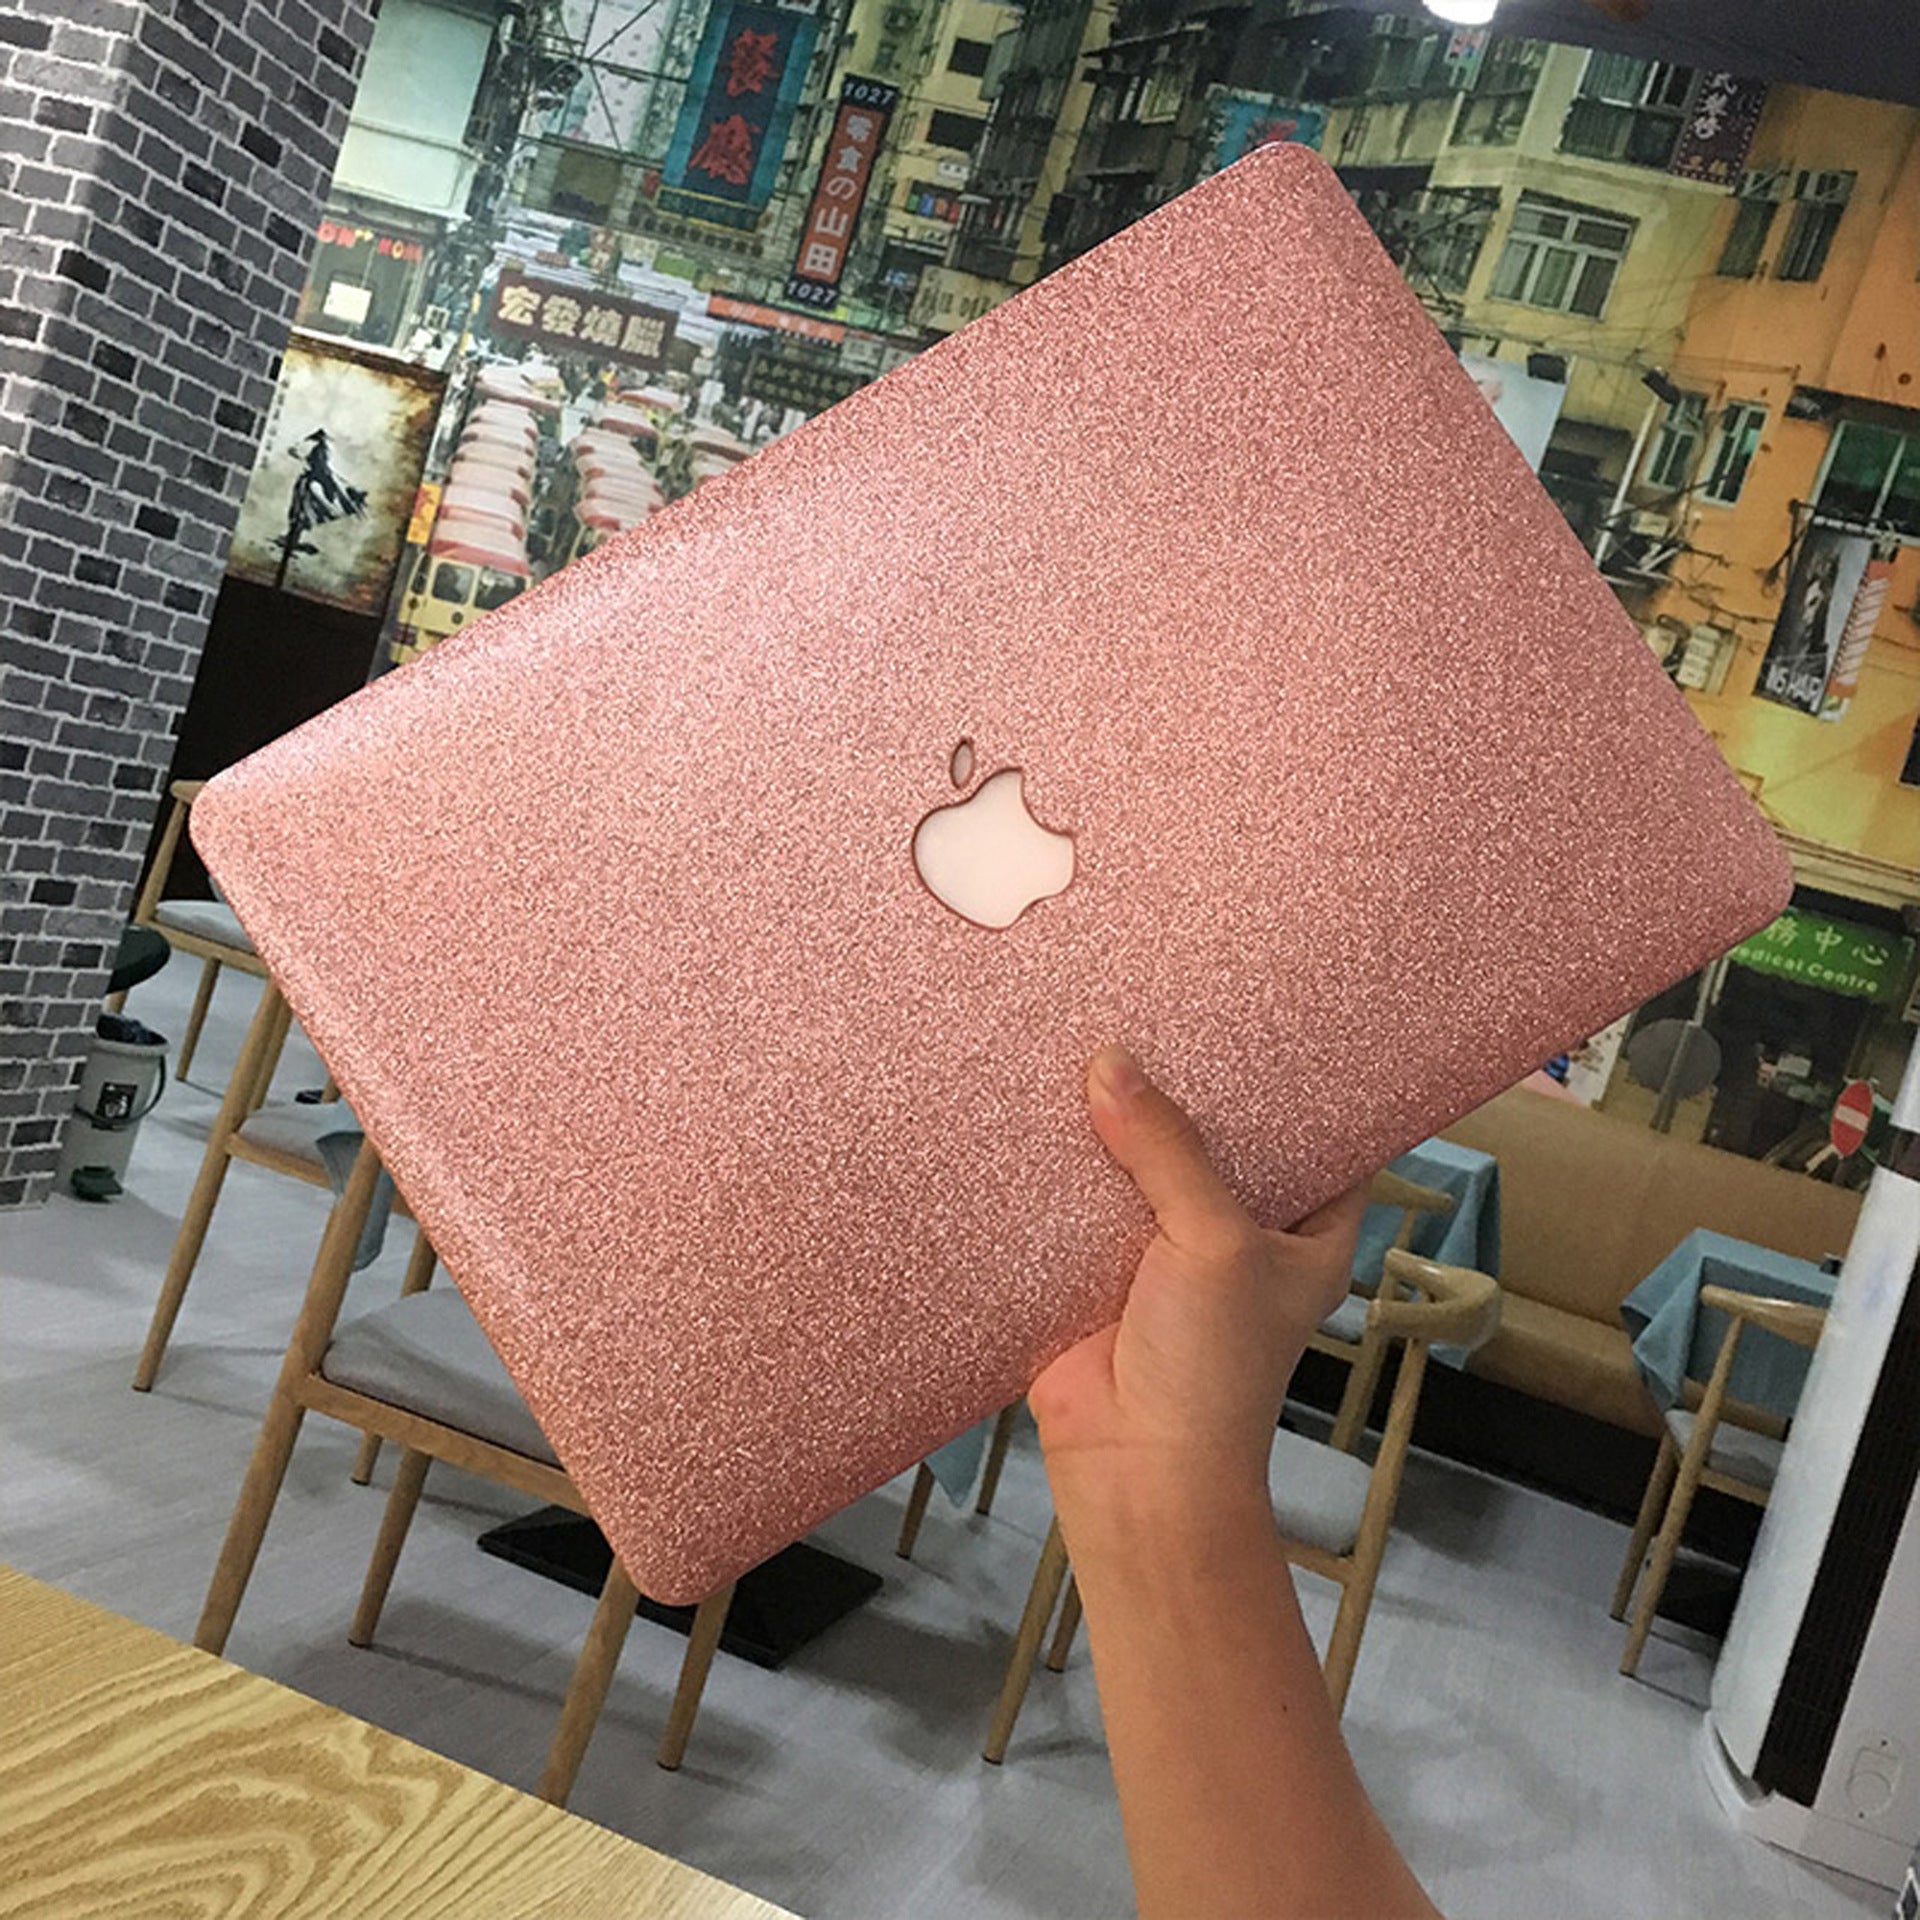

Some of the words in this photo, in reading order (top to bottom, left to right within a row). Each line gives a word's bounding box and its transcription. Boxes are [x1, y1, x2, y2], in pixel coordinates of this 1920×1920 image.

[844, 83, 895, 105] 1027
[788, 281, 837, 305] 1027
[1734, 946, 1803, 973] edical
[1807, 963, 1878, 993] Centre
